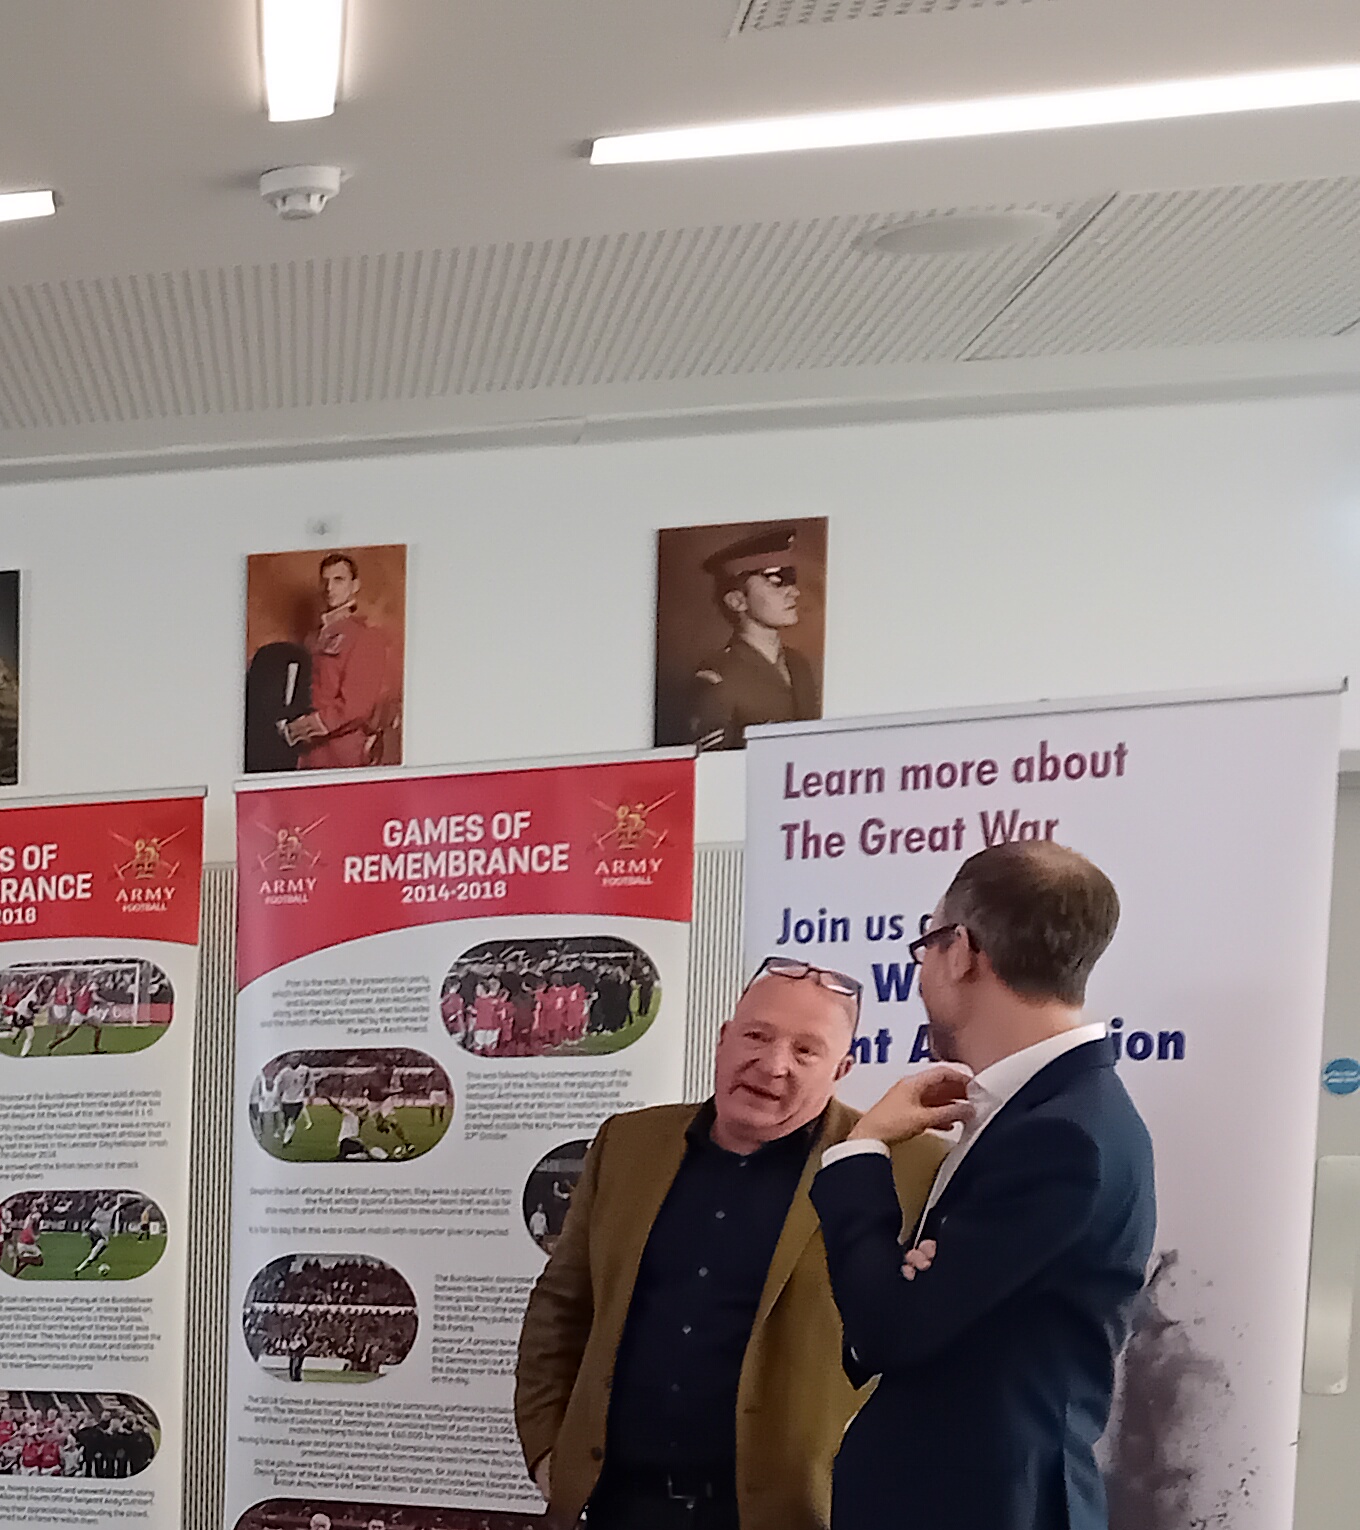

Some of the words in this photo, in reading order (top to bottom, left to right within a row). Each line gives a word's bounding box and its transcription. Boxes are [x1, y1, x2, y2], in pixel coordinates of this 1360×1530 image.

[783, 762, 886, 800] Learn
[900, 758, 1000, 791] more
[1012, 740, 1129, 784] about
[382, 814, 484, 847] GAMES
[491, 811, 531, 842] OF
[780, 819, 847, 860] The
[859, 817, 967, 855] Great
[979, 808, 1059, 847] War
[22, 843, 58, 871] OF
[344, 843, 570, 884] REMEMBRANCE
[595, 858, 663, 875] ARMY
[115, 887, 176, 902] ARMY
[260, 877, 317, 894] ARMY
[401, 880, 507, 904] 2014-2018
[776, 908, 851, 945] Join
[866, 914, 905, 941] us
